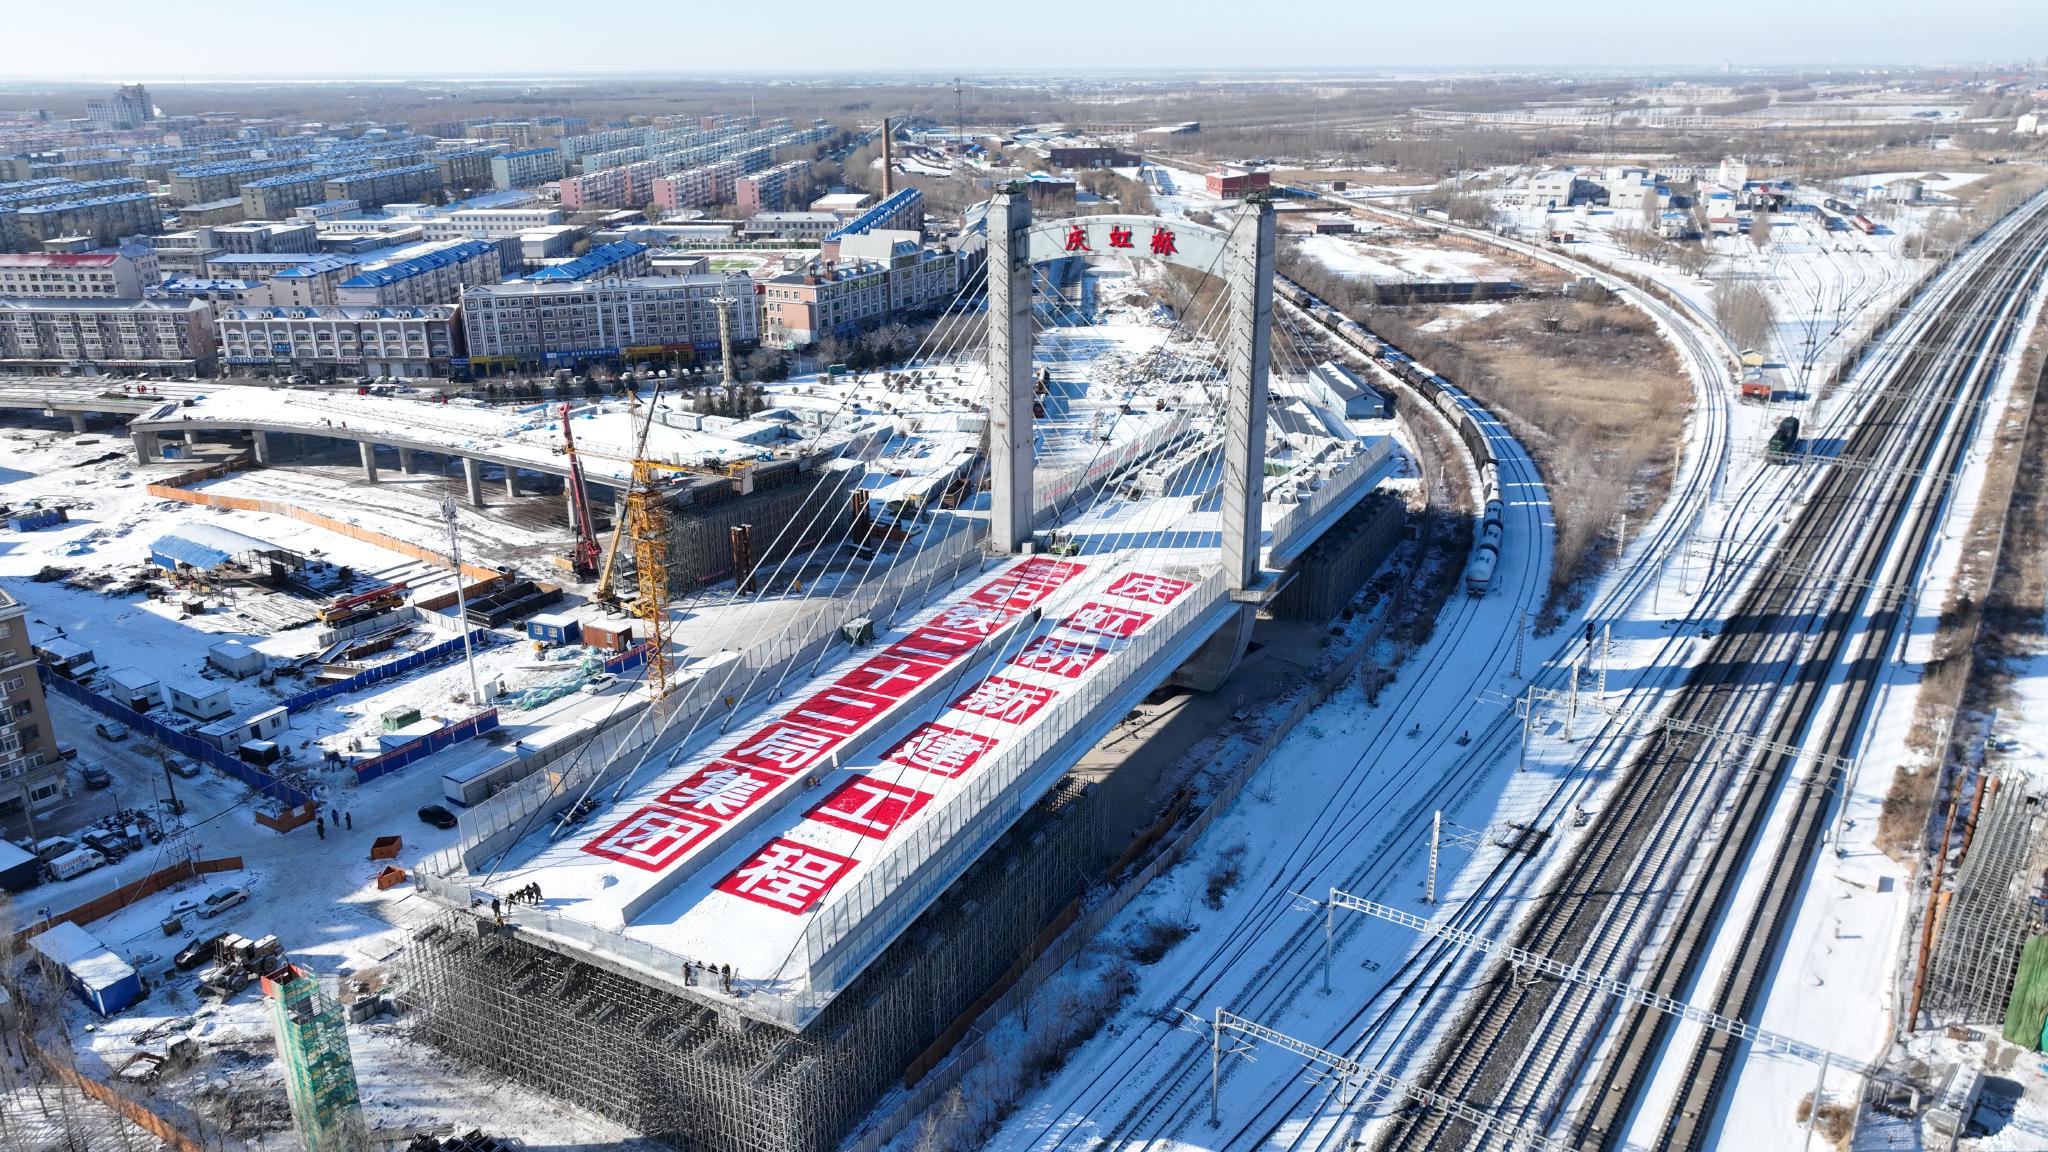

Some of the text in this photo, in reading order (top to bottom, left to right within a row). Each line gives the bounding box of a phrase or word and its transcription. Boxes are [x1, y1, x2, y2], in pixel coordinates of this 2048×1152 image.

[1065, 224, 1179, 256] 庆虹桥
[595, 584, 1044, 866] 中铁二十二局集团
[736, 576, 1184, 909] 庆虹桥新建工程
